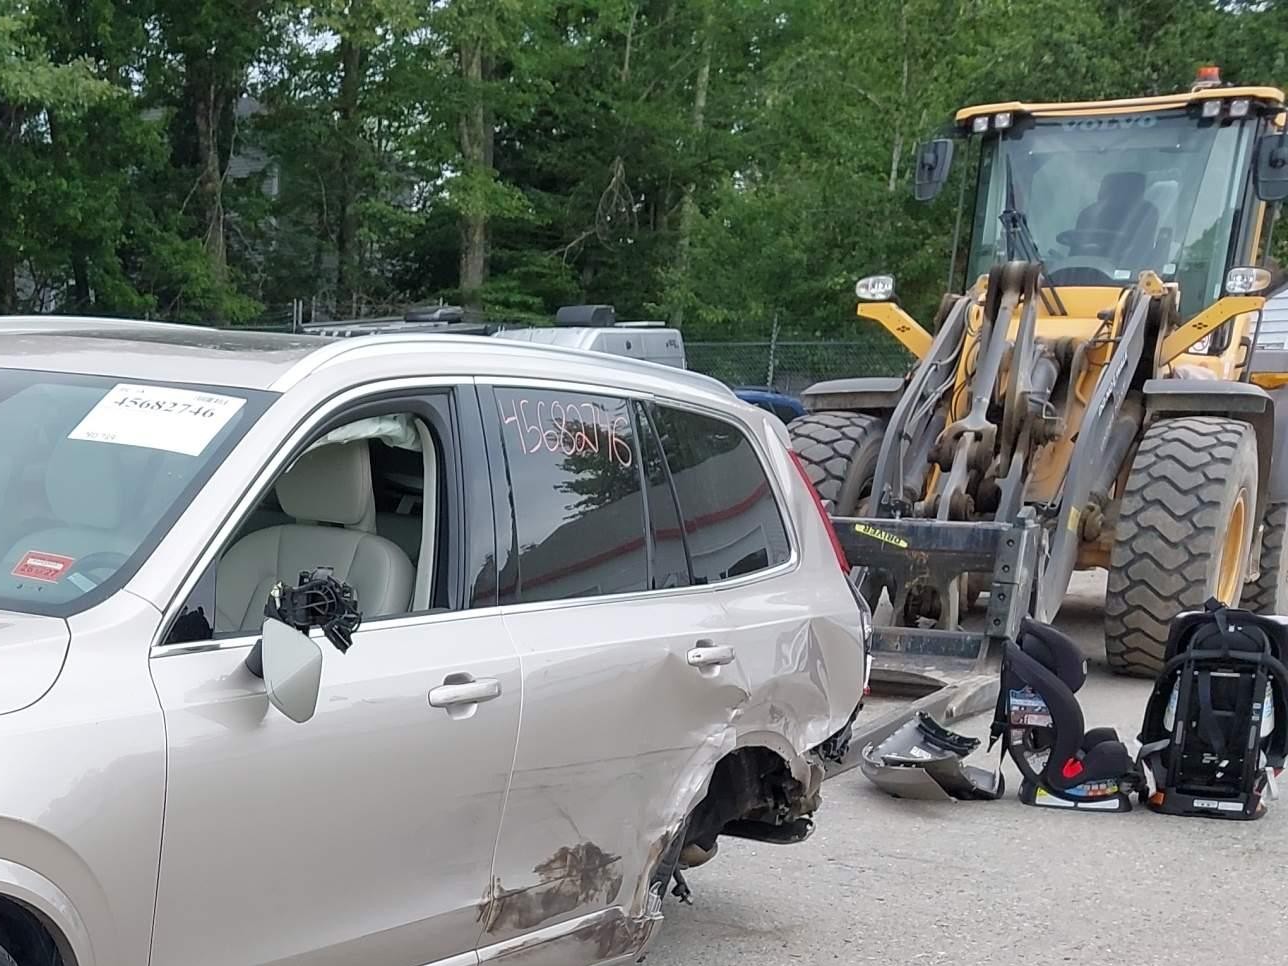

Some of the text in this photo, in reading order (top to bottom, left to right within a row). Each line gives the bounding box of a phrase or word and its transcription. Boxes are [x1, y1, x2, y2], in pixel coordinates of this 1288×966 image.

[1063, 115, 1157, 130] VOLVO
[114, 396, 215, 418] 45682746
[498, 399, 633, 468] 45682746
[862, 523, 902, 545] DRIVER
